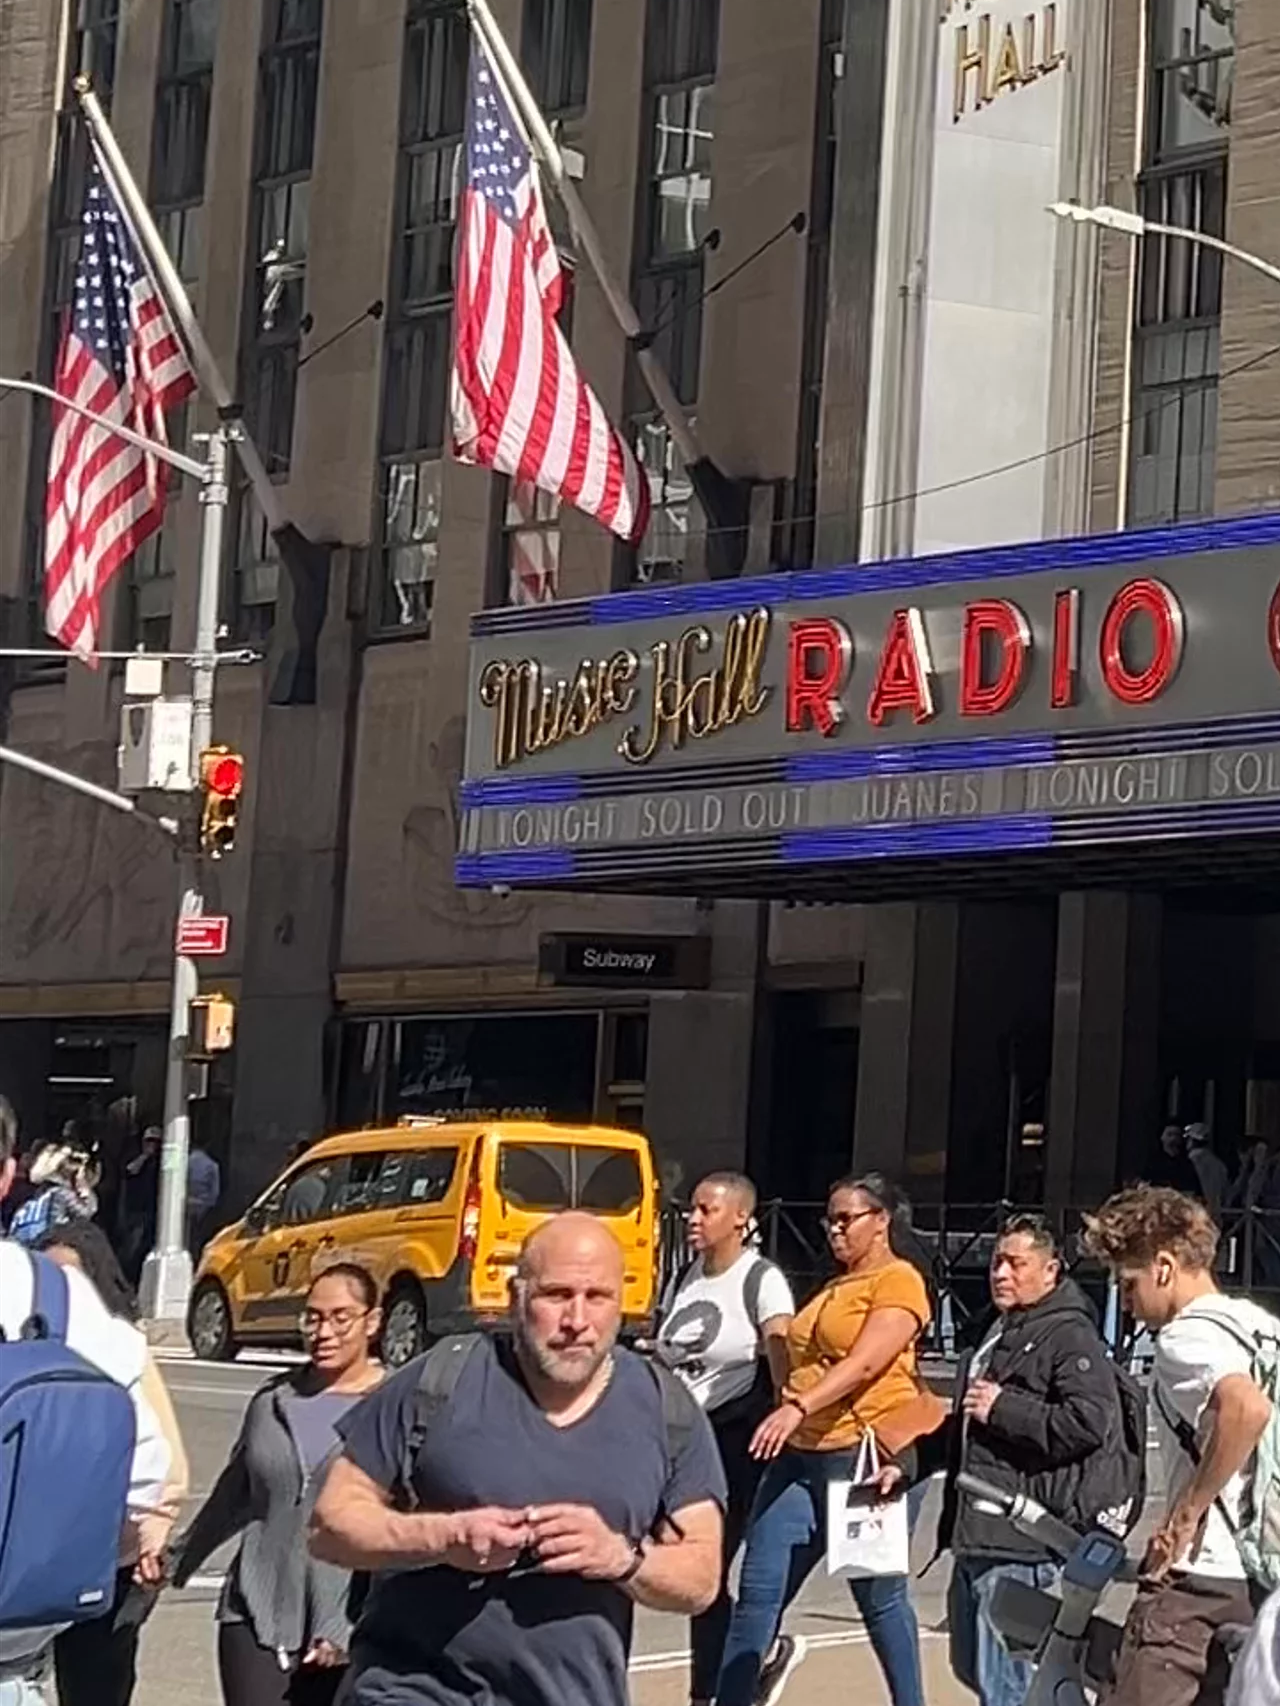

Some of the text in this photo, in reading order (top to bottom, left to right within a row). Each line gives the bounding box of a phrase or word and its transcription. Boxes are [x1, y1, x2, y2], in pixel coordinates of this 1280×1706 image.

[953, 1, 1069, 124] HALL
[480, 605, 772, 770] Music Hall
[787, 577, 1184, 738] RADIO
[501, 802, 618, 848] TONIGHT
[640, 794, 723, 838] SOLD
[742, 787, 806, 829] OUT
[853, 774, 981, 823] JUANES
[1026, 758, 1187, 811] TONIGHT
[582, 948, 656, 974] Subway
